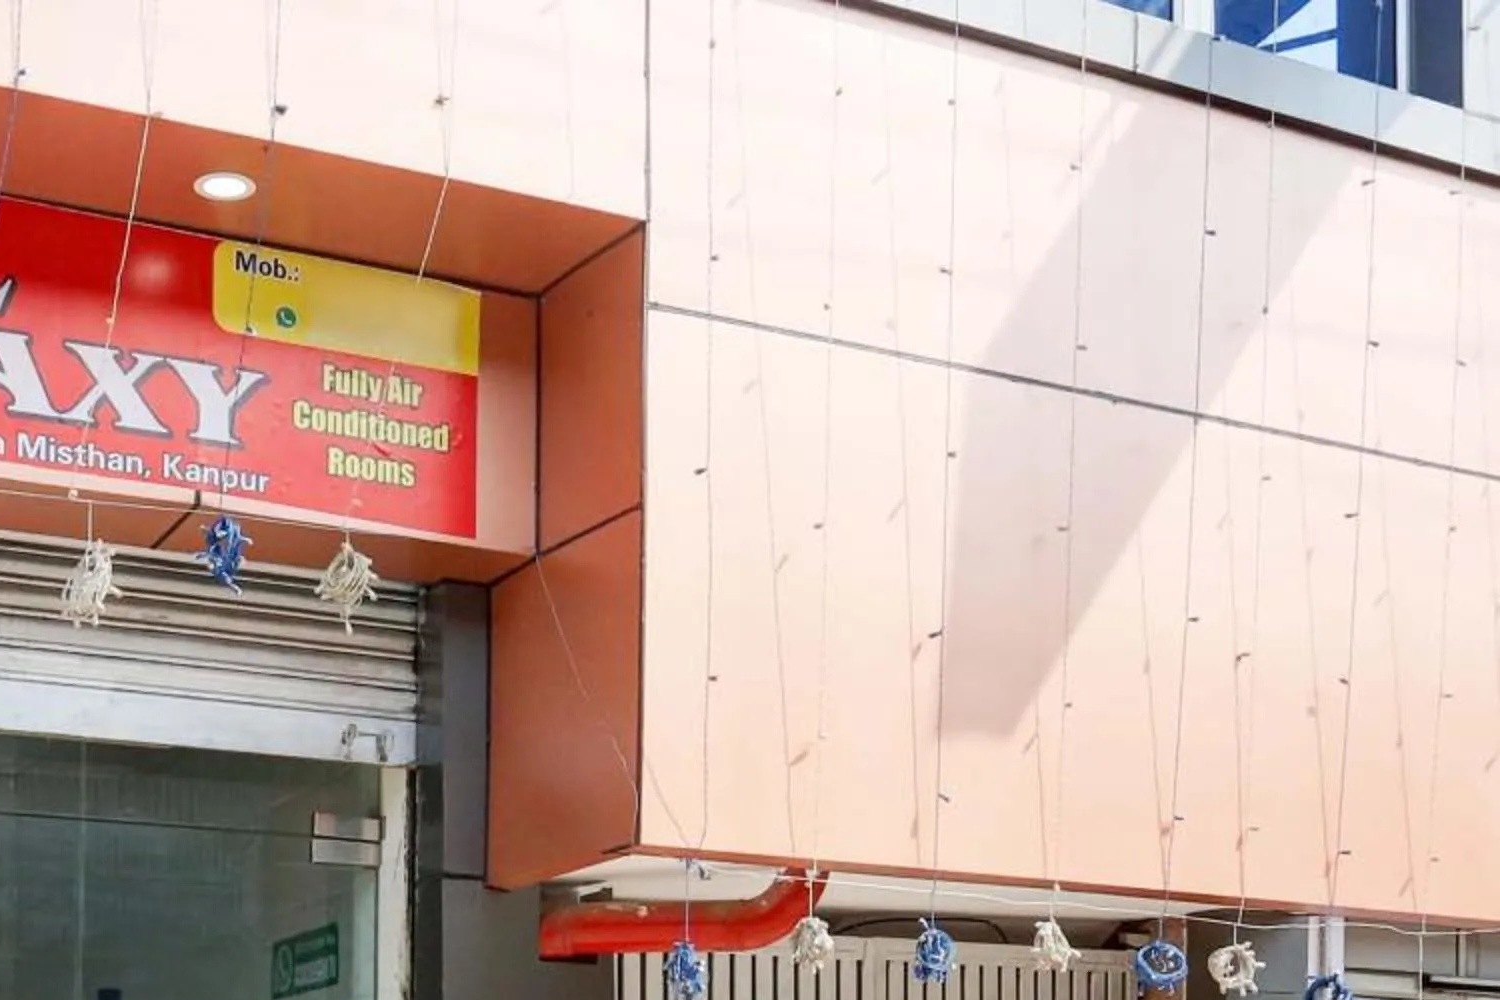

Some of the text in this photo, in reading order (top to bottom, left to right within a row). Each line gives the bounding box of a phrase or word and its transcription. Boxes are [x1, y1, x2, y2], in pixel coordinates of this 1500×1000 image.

[235, 250, 300, 282] Mob.:
[322, 363, 424, 407] Fully Air
[292, 400, 451, 453] Conditioned
[16, 432, 151, 478] Misthan,
[162, 452, 270, 495] Kanpur
[327, 447, 417, 487] Rooms
